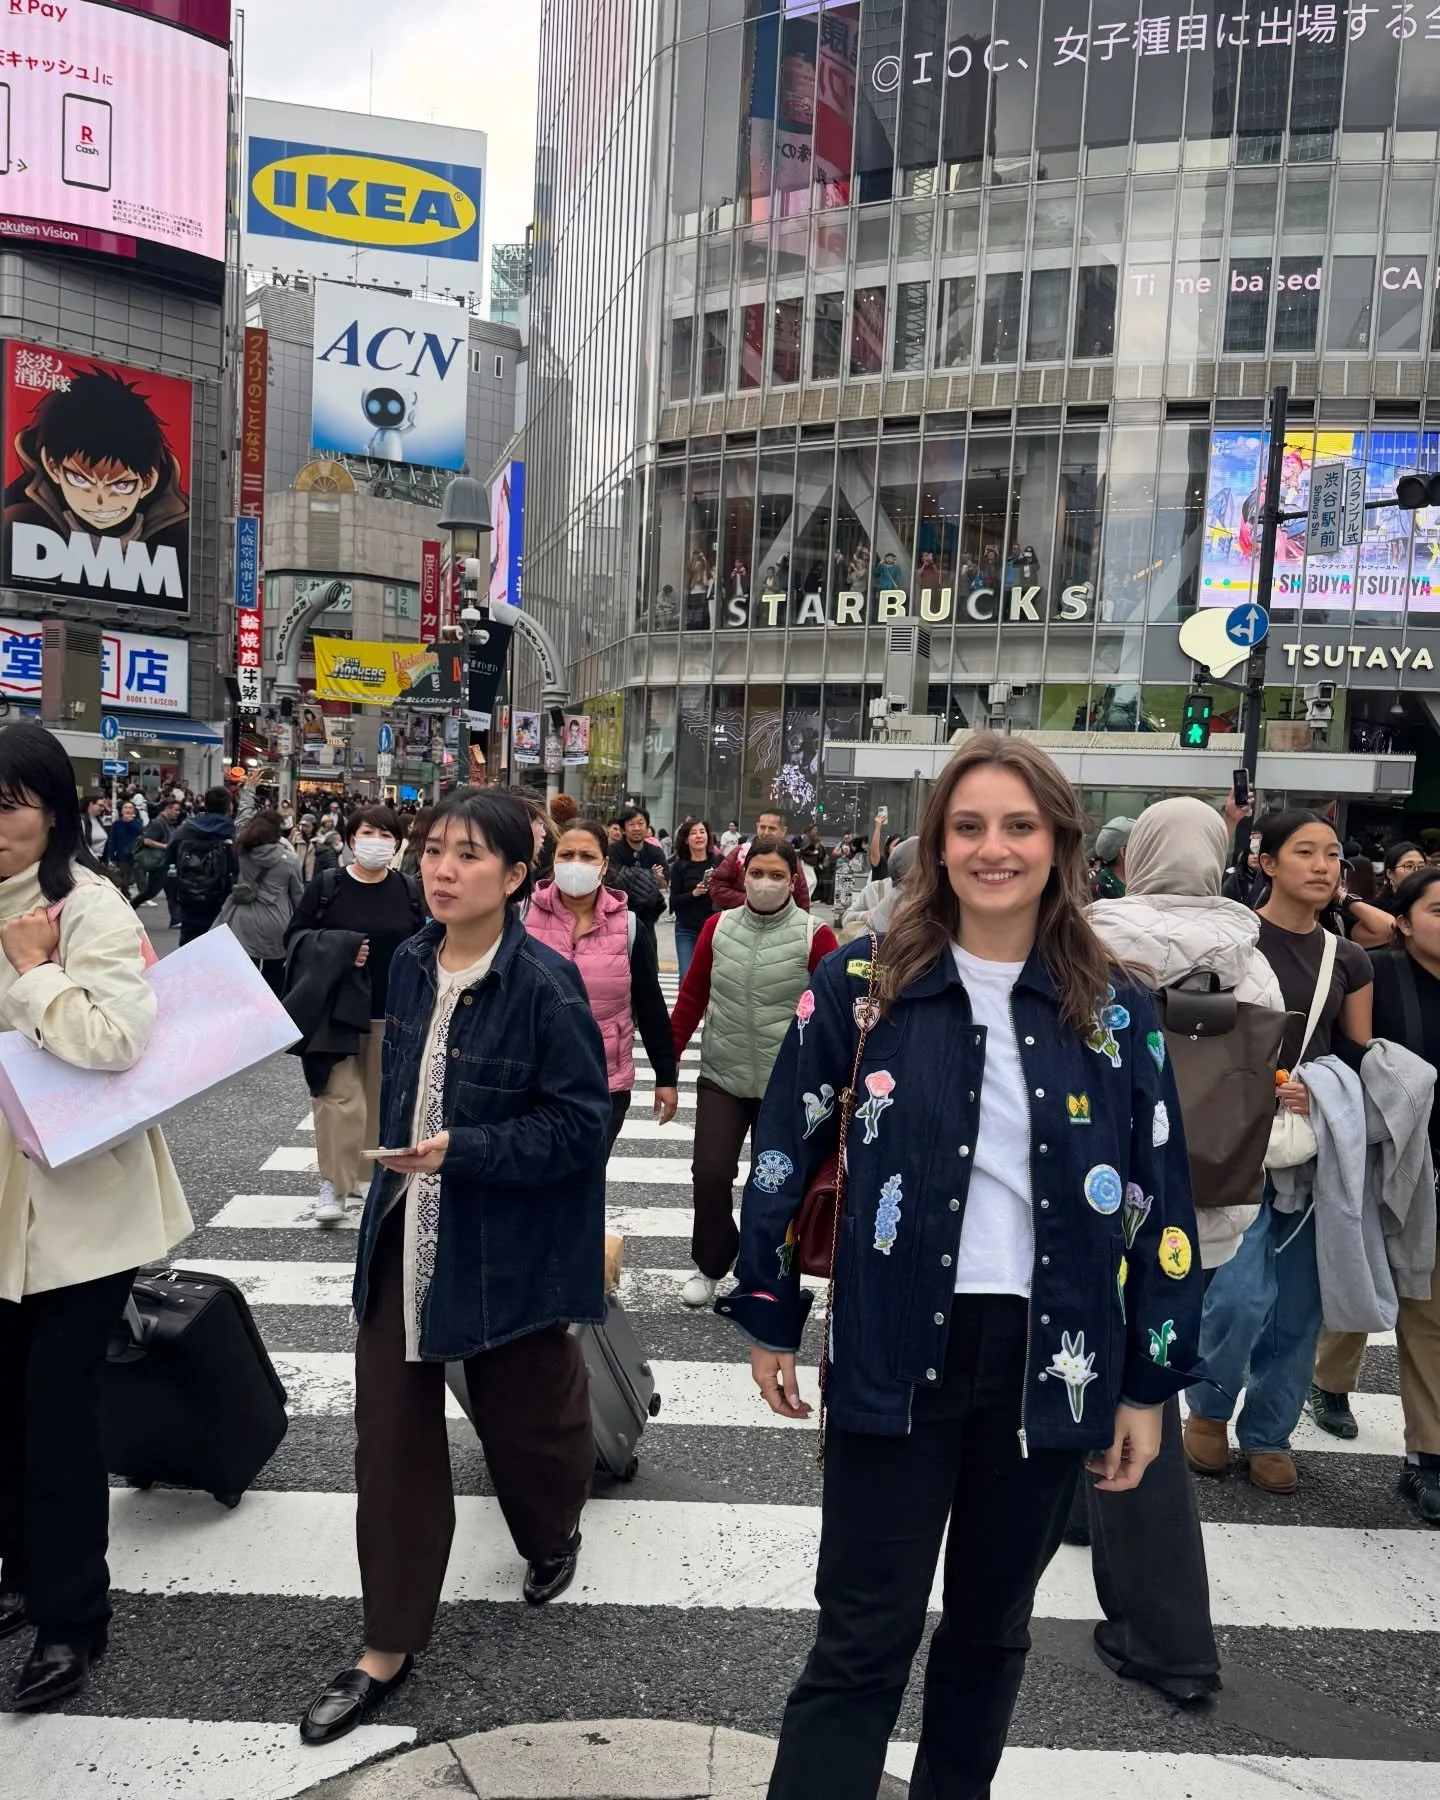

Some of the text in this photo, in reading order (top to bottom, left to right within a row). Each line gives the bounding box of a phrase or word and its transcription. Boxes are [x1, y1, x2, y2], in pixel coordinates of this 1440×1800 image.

[28, 0, 67, 22] Pay
[75, 144, 99, 156] Cash
[273, 169, 461, 229] IKEA
[42, 225, 79, 241] Vision
[16, 349, 63, 373] 炎炎ノ
[316, 320, 465, 381] ACN
[15, 367, 73, 393] 消防隊
[247, 335, 263, 462] クスリのことなら
[1312, 484, 1323, 520] Shibuya
[1320, 471, 1339, 548] 渋谷駅前
[1347, 471, 1362, 543] スクランブル式
[12, 521, 184, 599] DMM
[1279, 574, 1352, 594] SHBUYA
[727, 585, 1090, 627] STARBUCKS
[240, 608, 260, 666] 輪焼肉
[1283, 643, 1434, 670] TSUTAYA
[126, 695, 179, 707] BOOKS TAISEIDO
[242, 668, 258, 701] 牛繁
